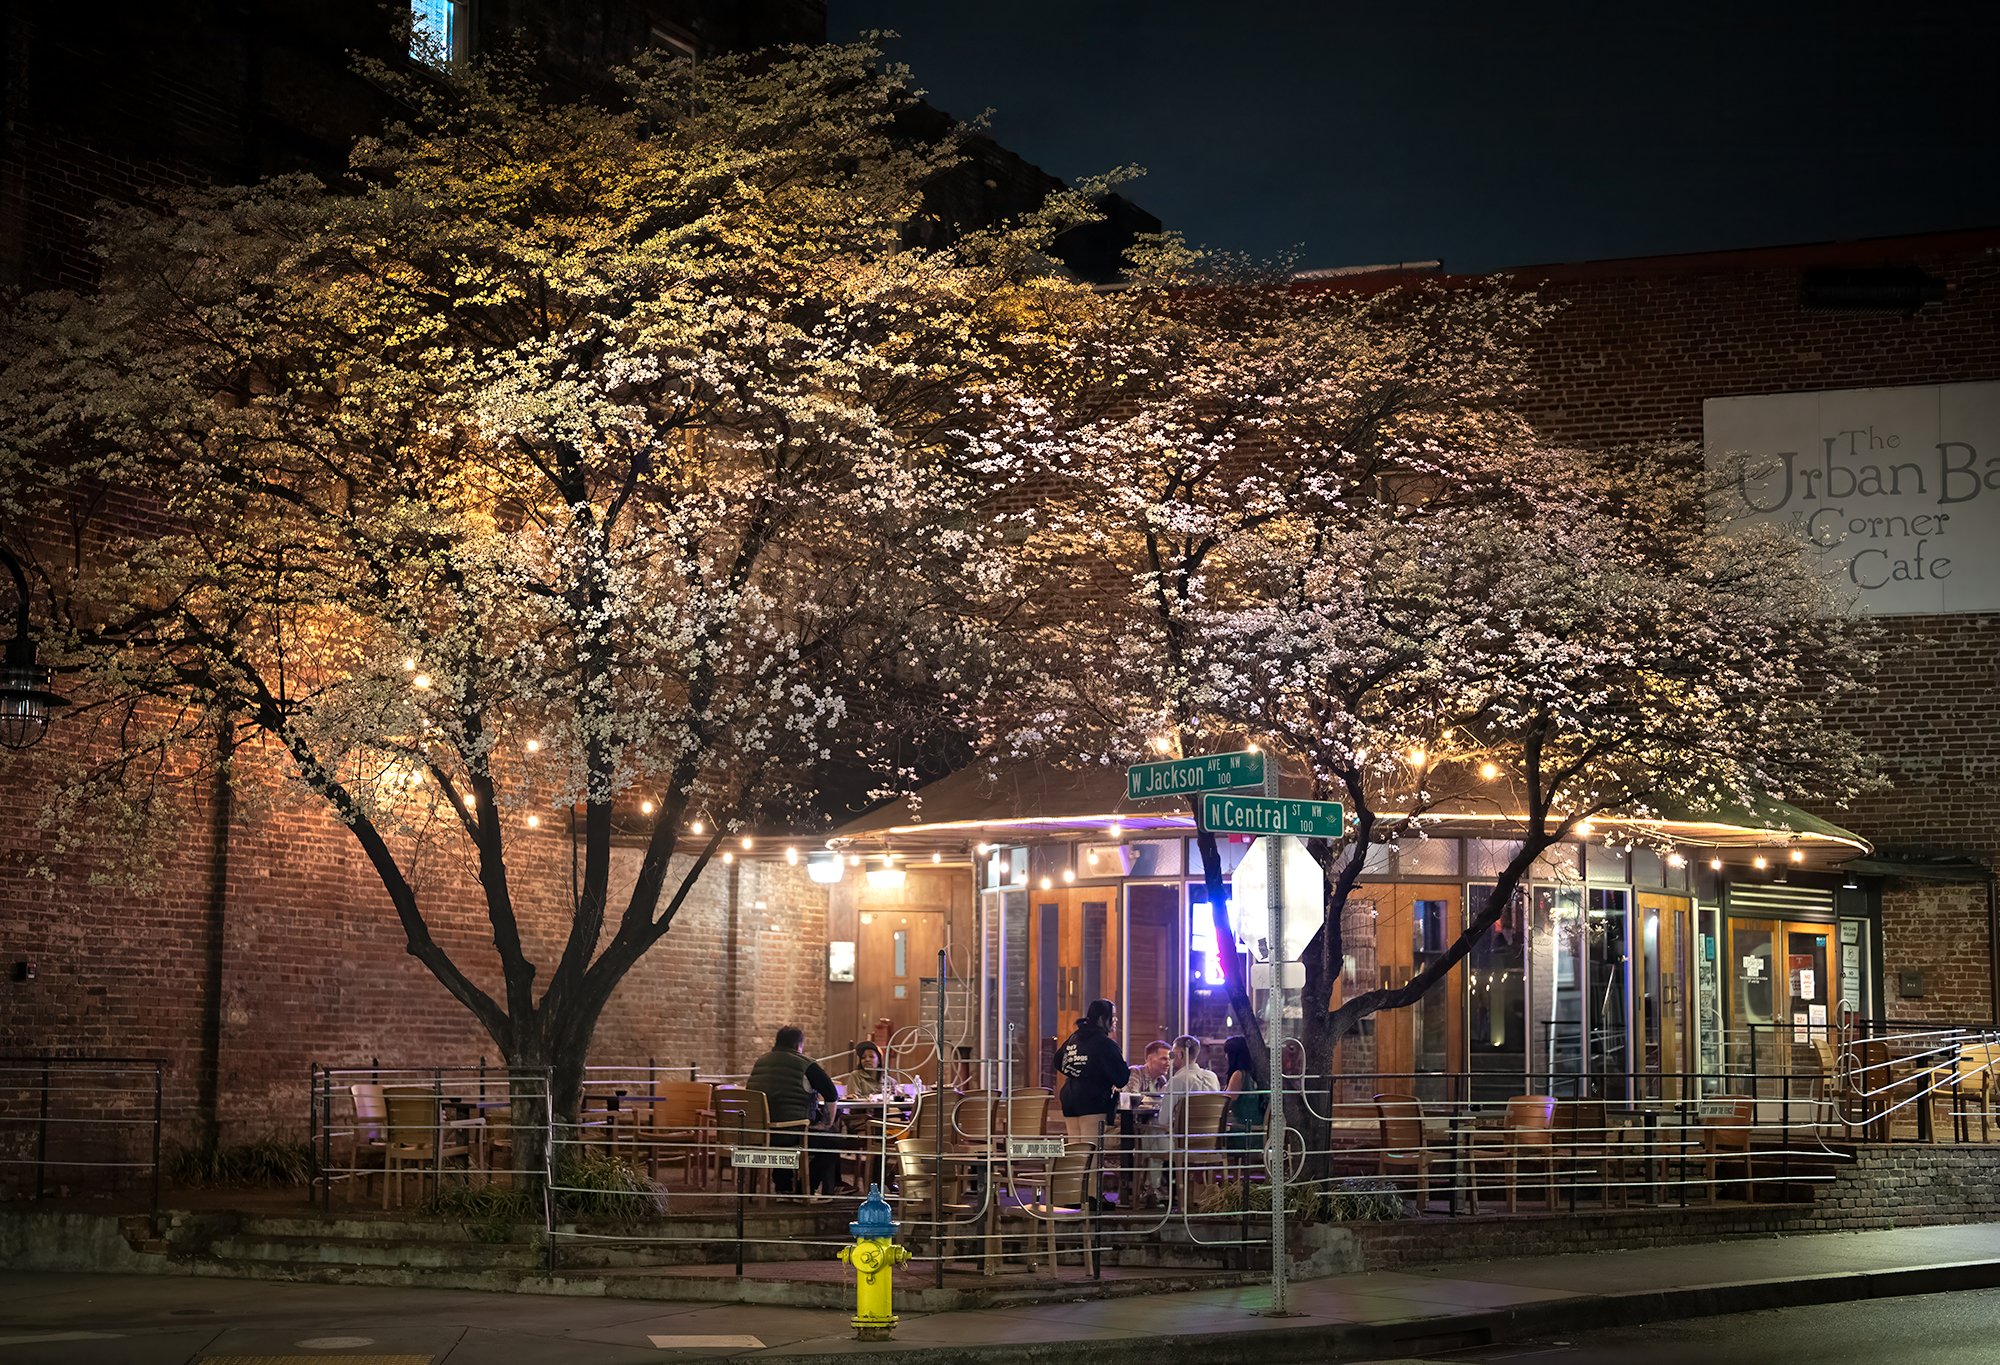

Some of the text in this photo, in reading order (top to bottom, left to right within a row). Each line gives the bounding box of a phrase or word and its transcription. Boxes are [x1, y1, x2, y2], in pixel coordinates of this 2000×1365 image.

[1839, 426, 1900, 455] The
[1738, 438, 1927, 514] Urban
[1806, 507, 1950, 548] Corner
[1850, 539, 1952, 590] Cafe
[1132, 756, 1241, 793] W Jackson AVE NW
[1218, 772, 1231, 785] 100
[1212, 798, 1322, 830] N Central ST NW
[1300, 820, 1314, 832] 100
[735, 1153, 795, 1165] DON'T JUMP THE FENCE
[1026, 1144, 1039, 1153] JUMP
[1040, 1144, 1048, 1153] THE
[1048, 1144, 1062, 1153] FENCE
